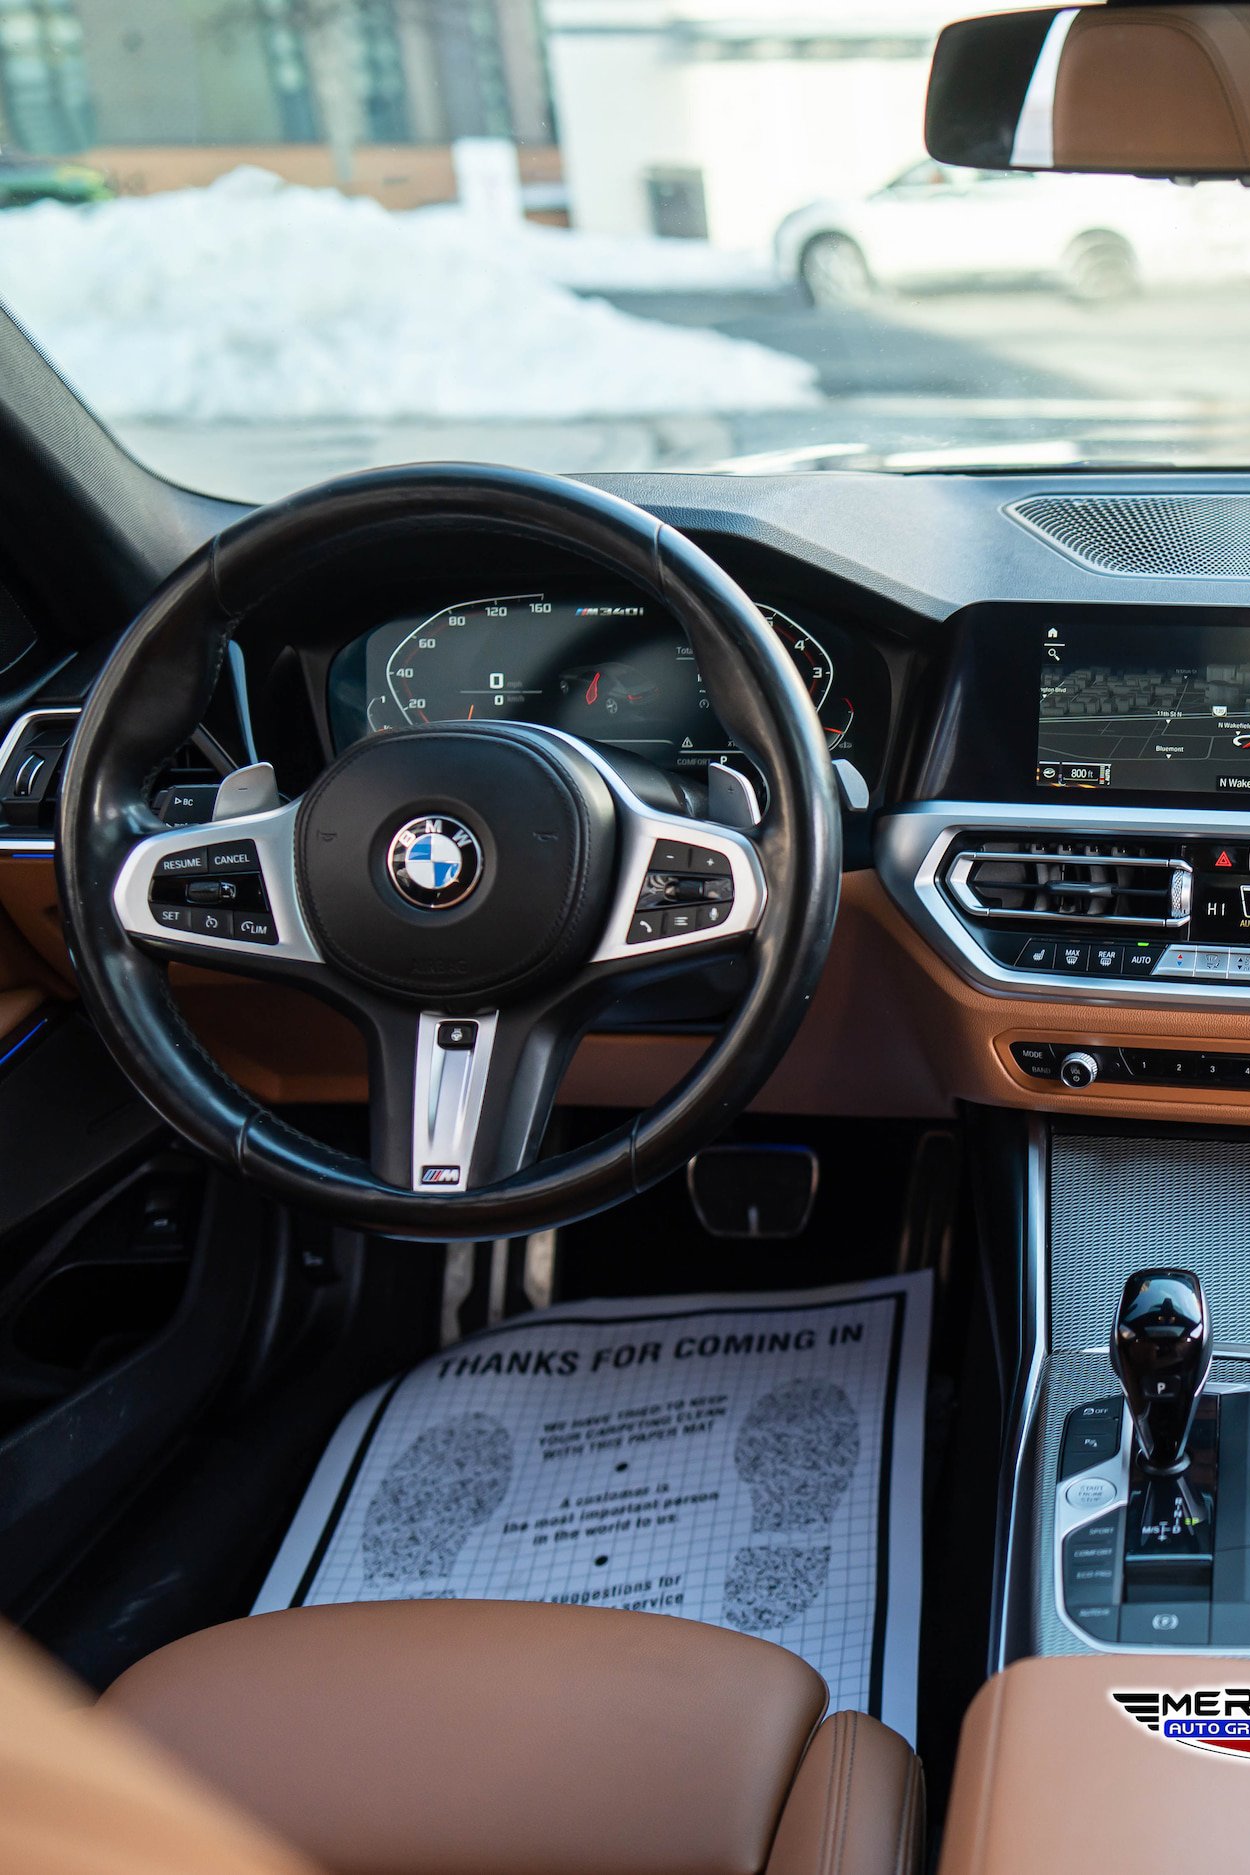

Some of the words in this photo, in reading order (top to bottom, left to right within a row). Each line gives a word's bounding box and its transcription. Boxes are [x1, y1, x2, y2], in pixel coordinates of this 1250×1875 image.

[485, 606, 507, 617] 120
[529, 603, 552, 613] 160
[449, 616, 466, 626] 80
[418, 638, 436, 649] 60
[794, 640, 805, 650] 4
[396, 668, 414, 678] 40
[812, 667, 823, 678] 3
[489, 672, 504, 690] 0
[408, 698, 426, 709] 20
[494, 694, 504, 706] 0
[1156, 745, 1184, 753] Bluemont
[720, 756, 728, 765] P
[1071, 768, 1087, 778] 800
[1220, 778, 1227, 787] N
[398, 819, 472, 848] BMW
[163, 858, 202, 870] RESUME
[214, 854, 250, 865] CANCEL
[162, 911, 180, 921] SET
[250, 925, 267, 934] LIM
[1065, 949, 1080, 957] MAX
[1131, 956, 1151, 965] AUTO
[1022, 1050, 1043, 1059] MODE
[1210, 1065, 1215, 1073] 3
[437, 1349, 579, 1380] THANKS
[592, 1342, 662, 1372] FOR
[673, 1327, 815, 1359] COMING
[830, 1323, 864, 1345] IN
[1157, 1382, 1166, 1394] P
[659, 1574, 682, 1590] for
